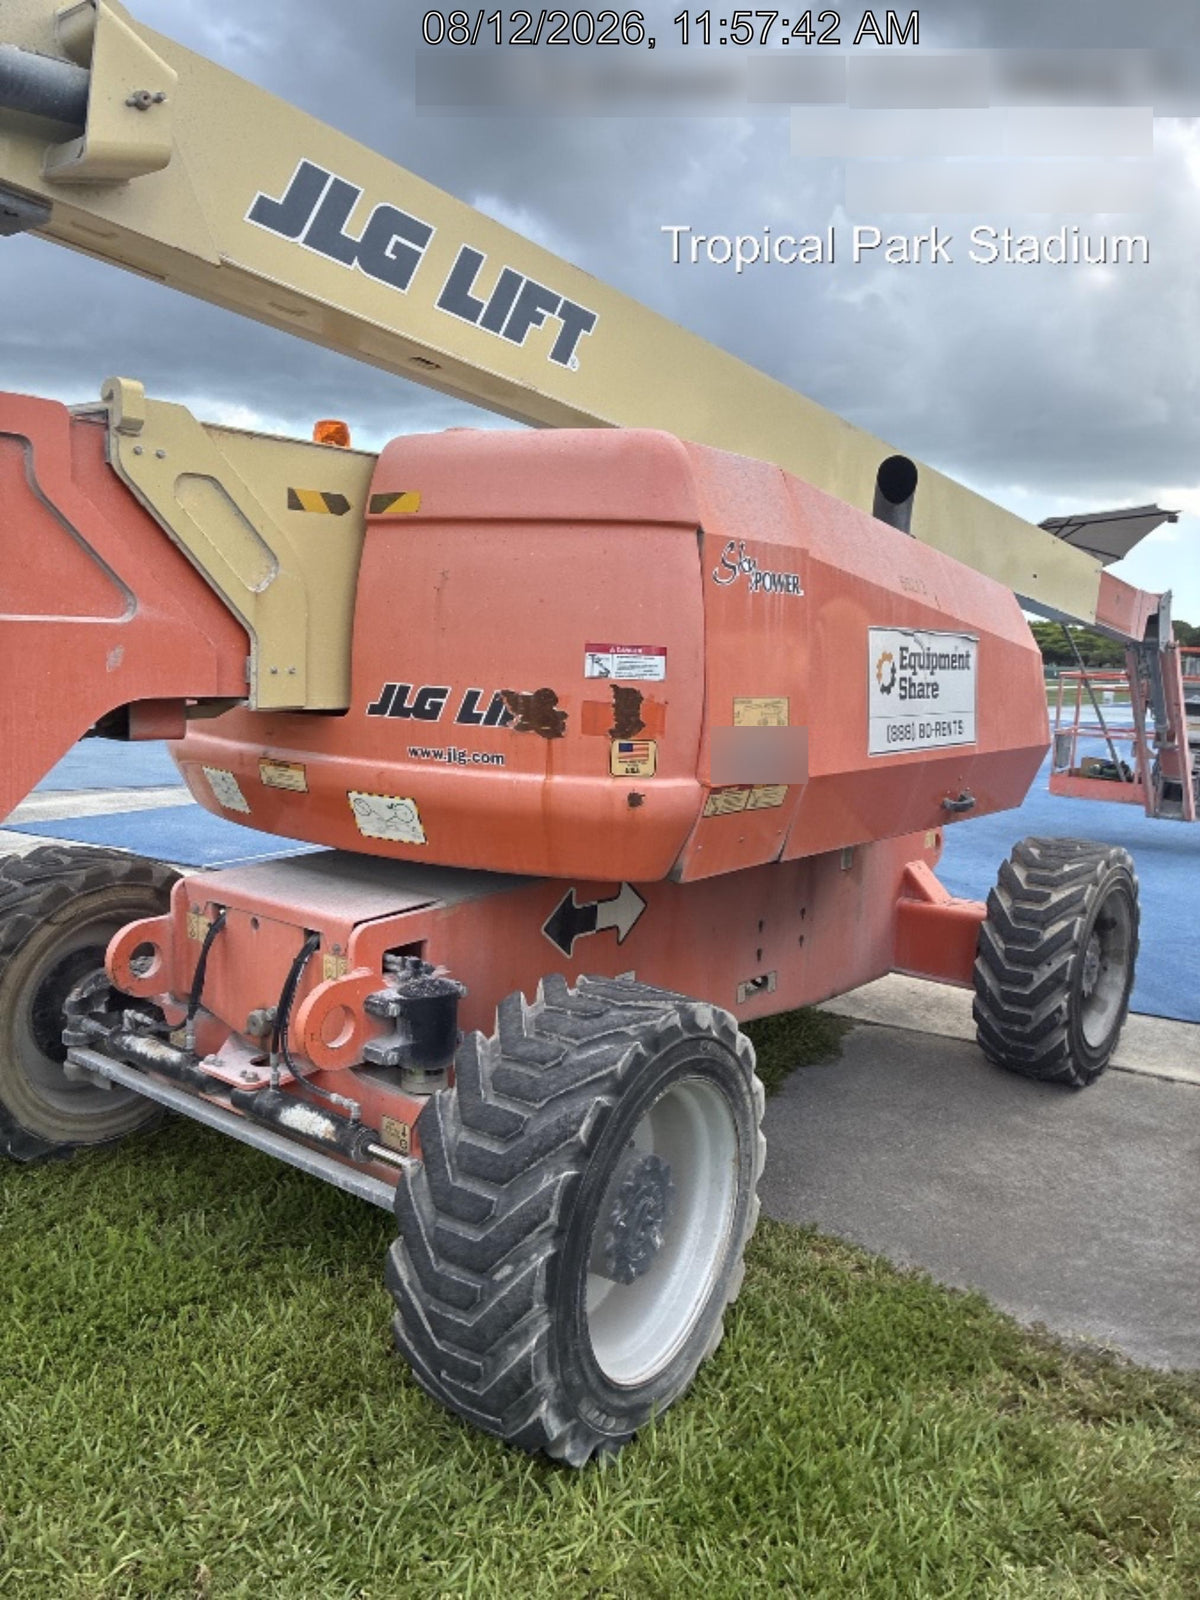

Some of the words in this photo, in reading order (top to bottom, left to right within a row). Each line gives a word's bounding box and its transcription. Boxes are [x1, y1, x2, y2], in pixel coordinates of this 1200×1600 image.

[244, 158, 437, 295] JLG
[434, 243, 600, 370] LIFT
[754, 571, 801, 595] POWER
[899, 646, 972, 676] Equipment
[898, 676, 940, 700] Share
[366, 682, 451, 722] JLG
[886, 722, 916, 744] (888)
[408, 745, 505, 766] www.jlg.com
